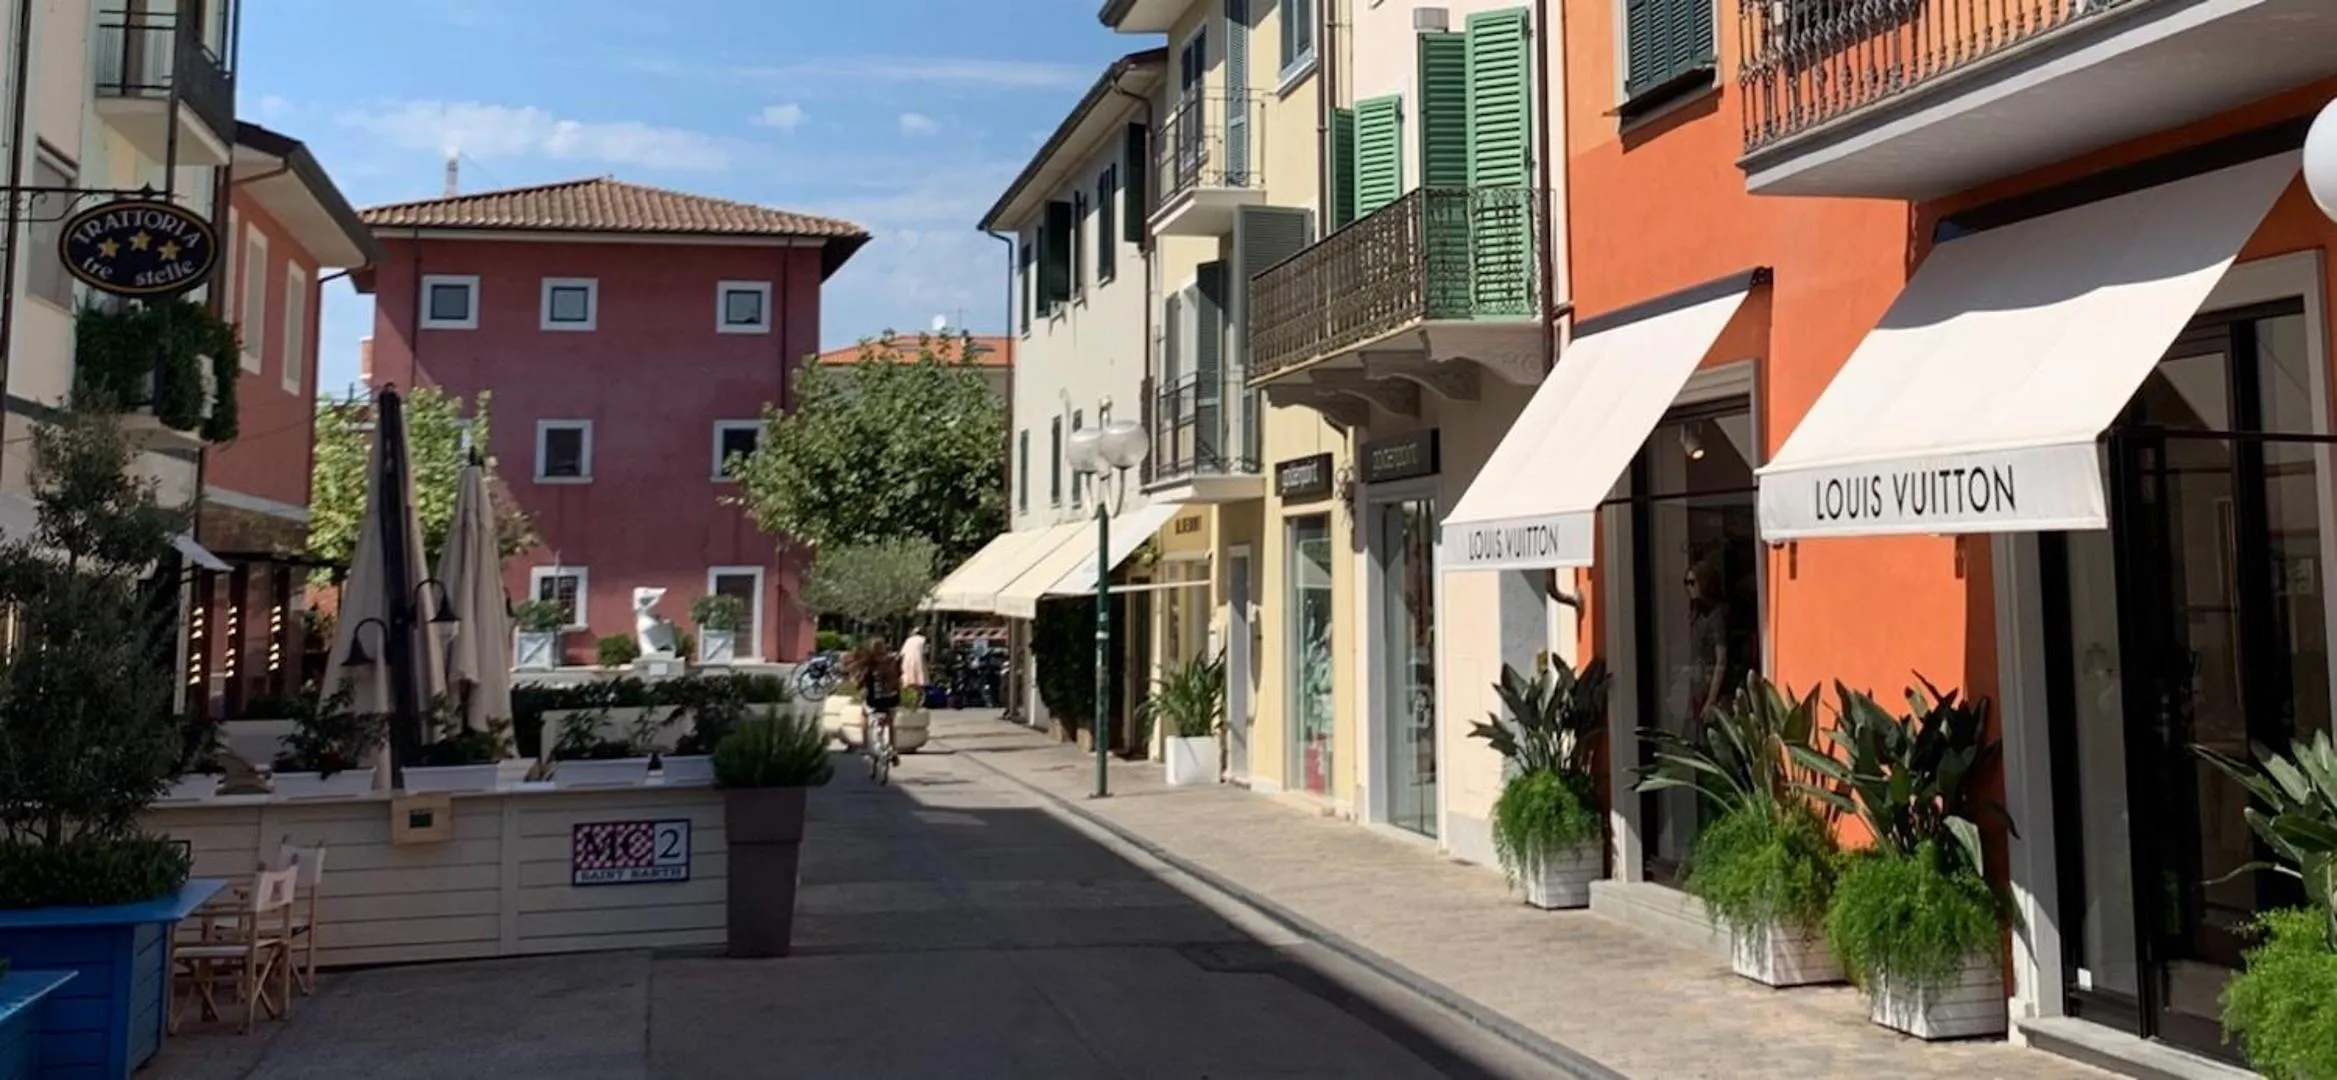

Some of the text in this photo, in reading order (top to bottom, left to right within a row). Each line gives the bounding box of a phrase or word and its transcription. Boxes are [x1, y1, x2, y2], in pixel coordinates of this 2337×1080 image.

[73, 211, 201, 248] TRATTORIA
[82, 256, 196, 286] tre stelle
[1816, 464, 2017, 520] LOUIS VUITTON
[1468, 523, 1560, 560] LOUIS VUITTON
[659, 828, 682, 859] 2
[581, 868, 623, 880] SAINT
